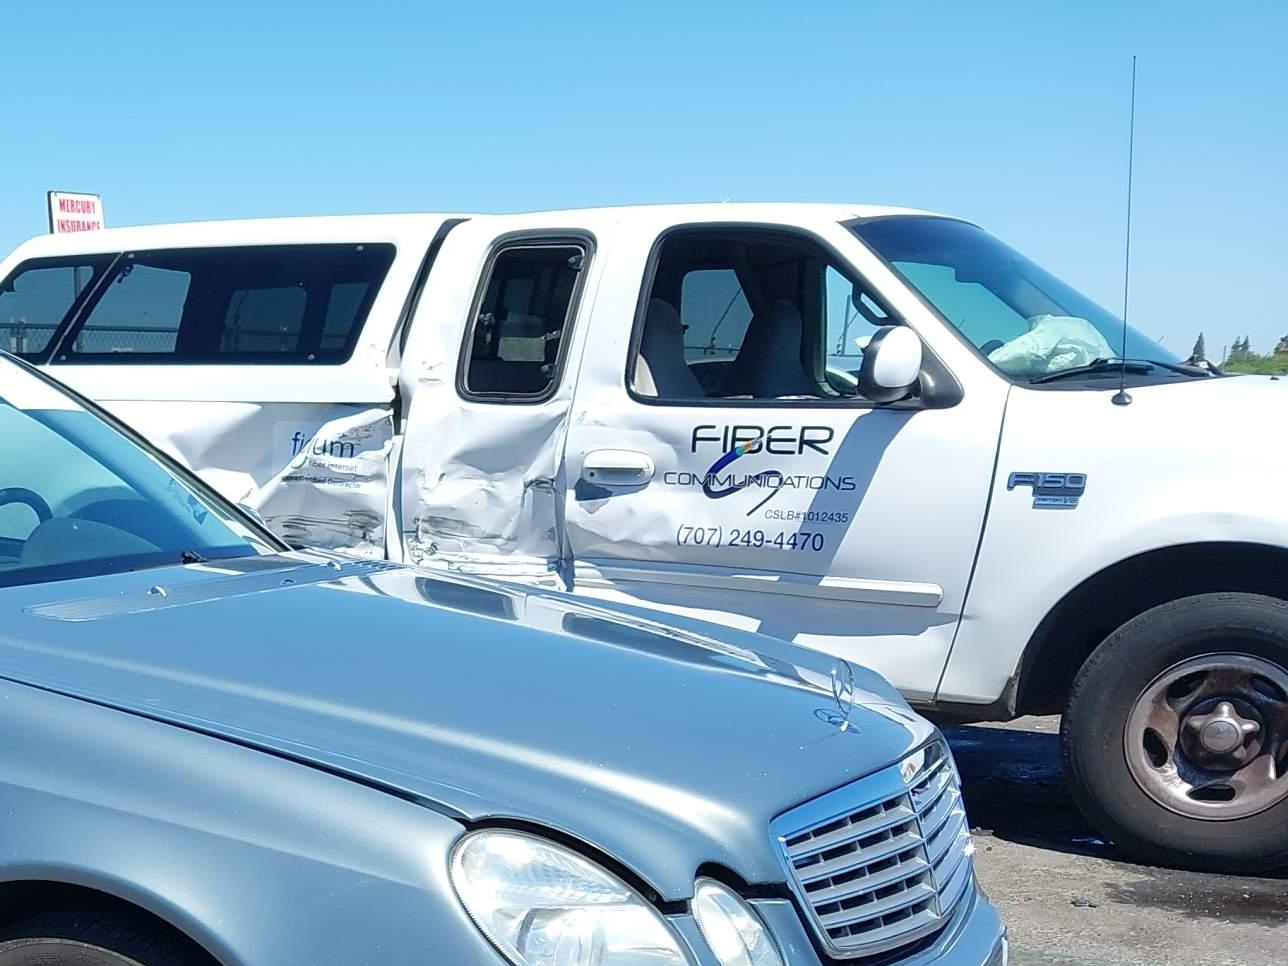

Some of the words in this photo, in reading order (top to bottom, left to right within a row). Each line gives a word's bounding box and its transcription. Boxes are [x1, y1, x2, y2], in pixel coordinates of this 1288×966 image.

[58, 198, 95, 214] MERCURY
[691, 424, 834, 455] FIBER
[664, 471, 857, 491] COMMUNICATIONS
[764, 509, 849, 523] CSLB#1012435
[676, 524, 723, 547] (707)
[728, 528, 825, 551] 249-4470
